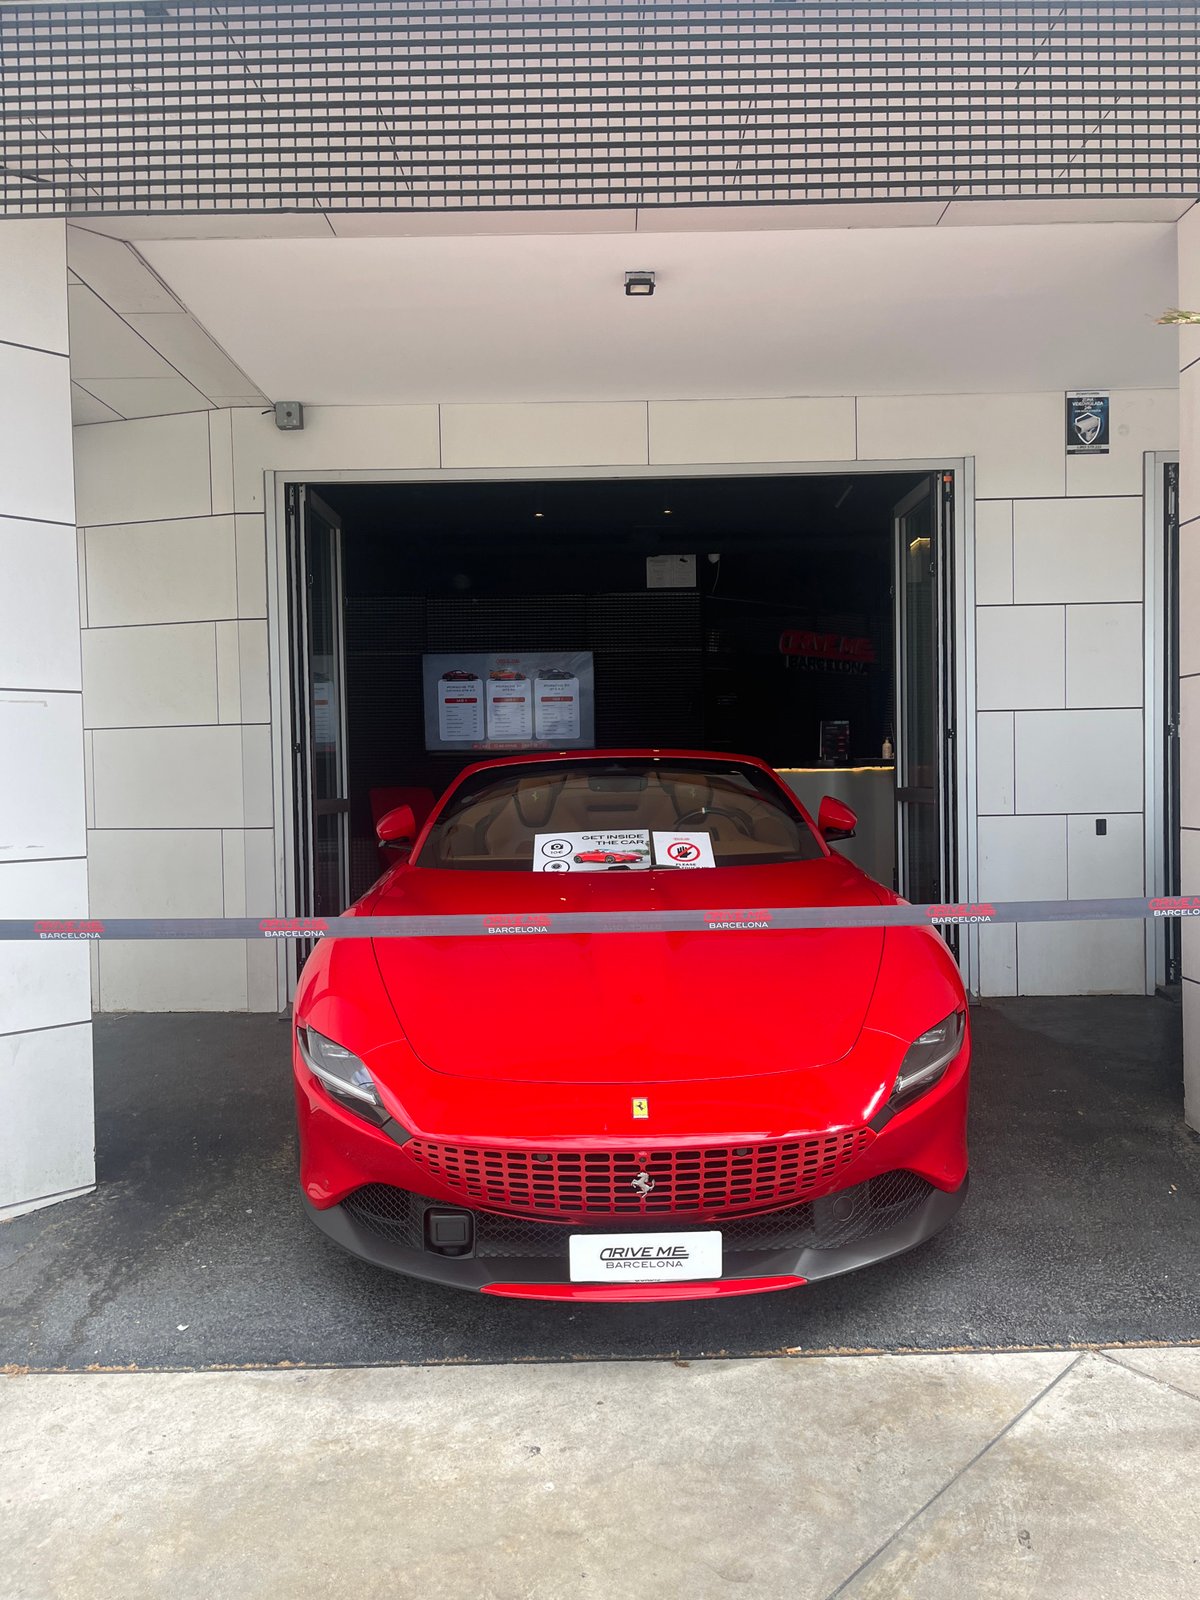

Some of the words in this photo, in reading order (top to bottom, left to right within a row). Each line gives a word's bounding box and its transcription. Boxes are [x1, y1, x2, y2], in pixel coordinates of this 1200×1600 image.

[931, 915, 992, 923] BARCELONA
[709, 921, 769, 929] BARCELONA
[600, 1247, 654, 1261] DRIVE
[656, 1246, 690, 1259] ME
[606, 1261, 684, 1269] BARCELONA
